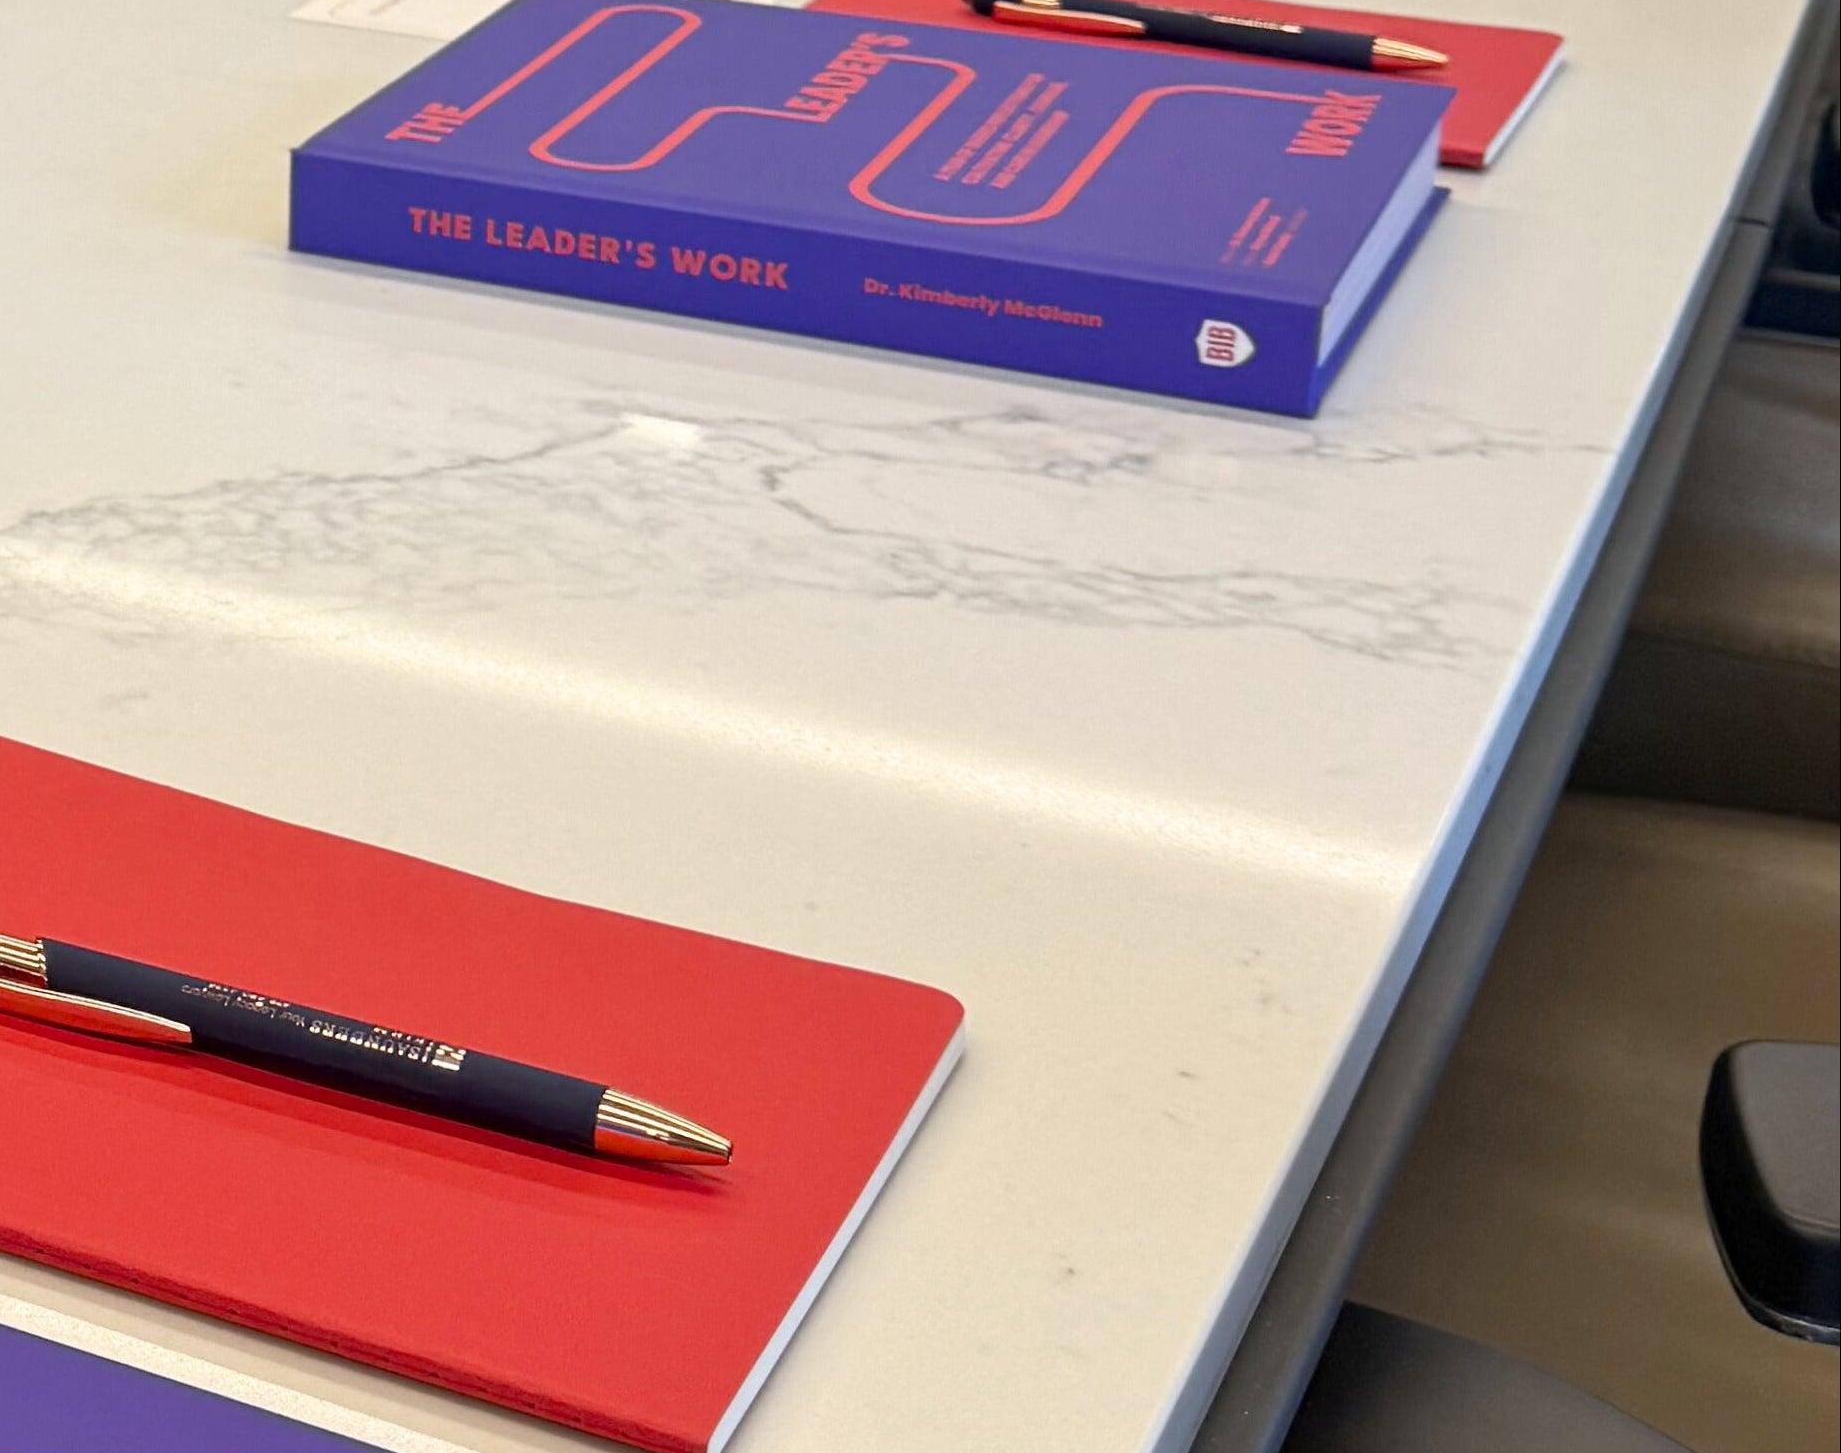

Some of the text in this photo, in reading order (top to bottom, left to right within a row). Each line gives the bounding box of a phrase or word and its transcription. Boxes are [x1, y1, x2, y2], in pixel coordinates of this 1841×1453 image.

[385, 102, 465, 144] THE
[1284, 90, 1383, 157] WORK
[409, 207, 789, 290] THE LEADER'S WORK
[864, 277, 894, 296] Dr.
[899, 283, 999, 317] Kimberly
[1206, 326, 1236, 362] BIB
[280, 1009, 306, 1028] Your
[310, 1019, 419, 1060] SAUNDERS
